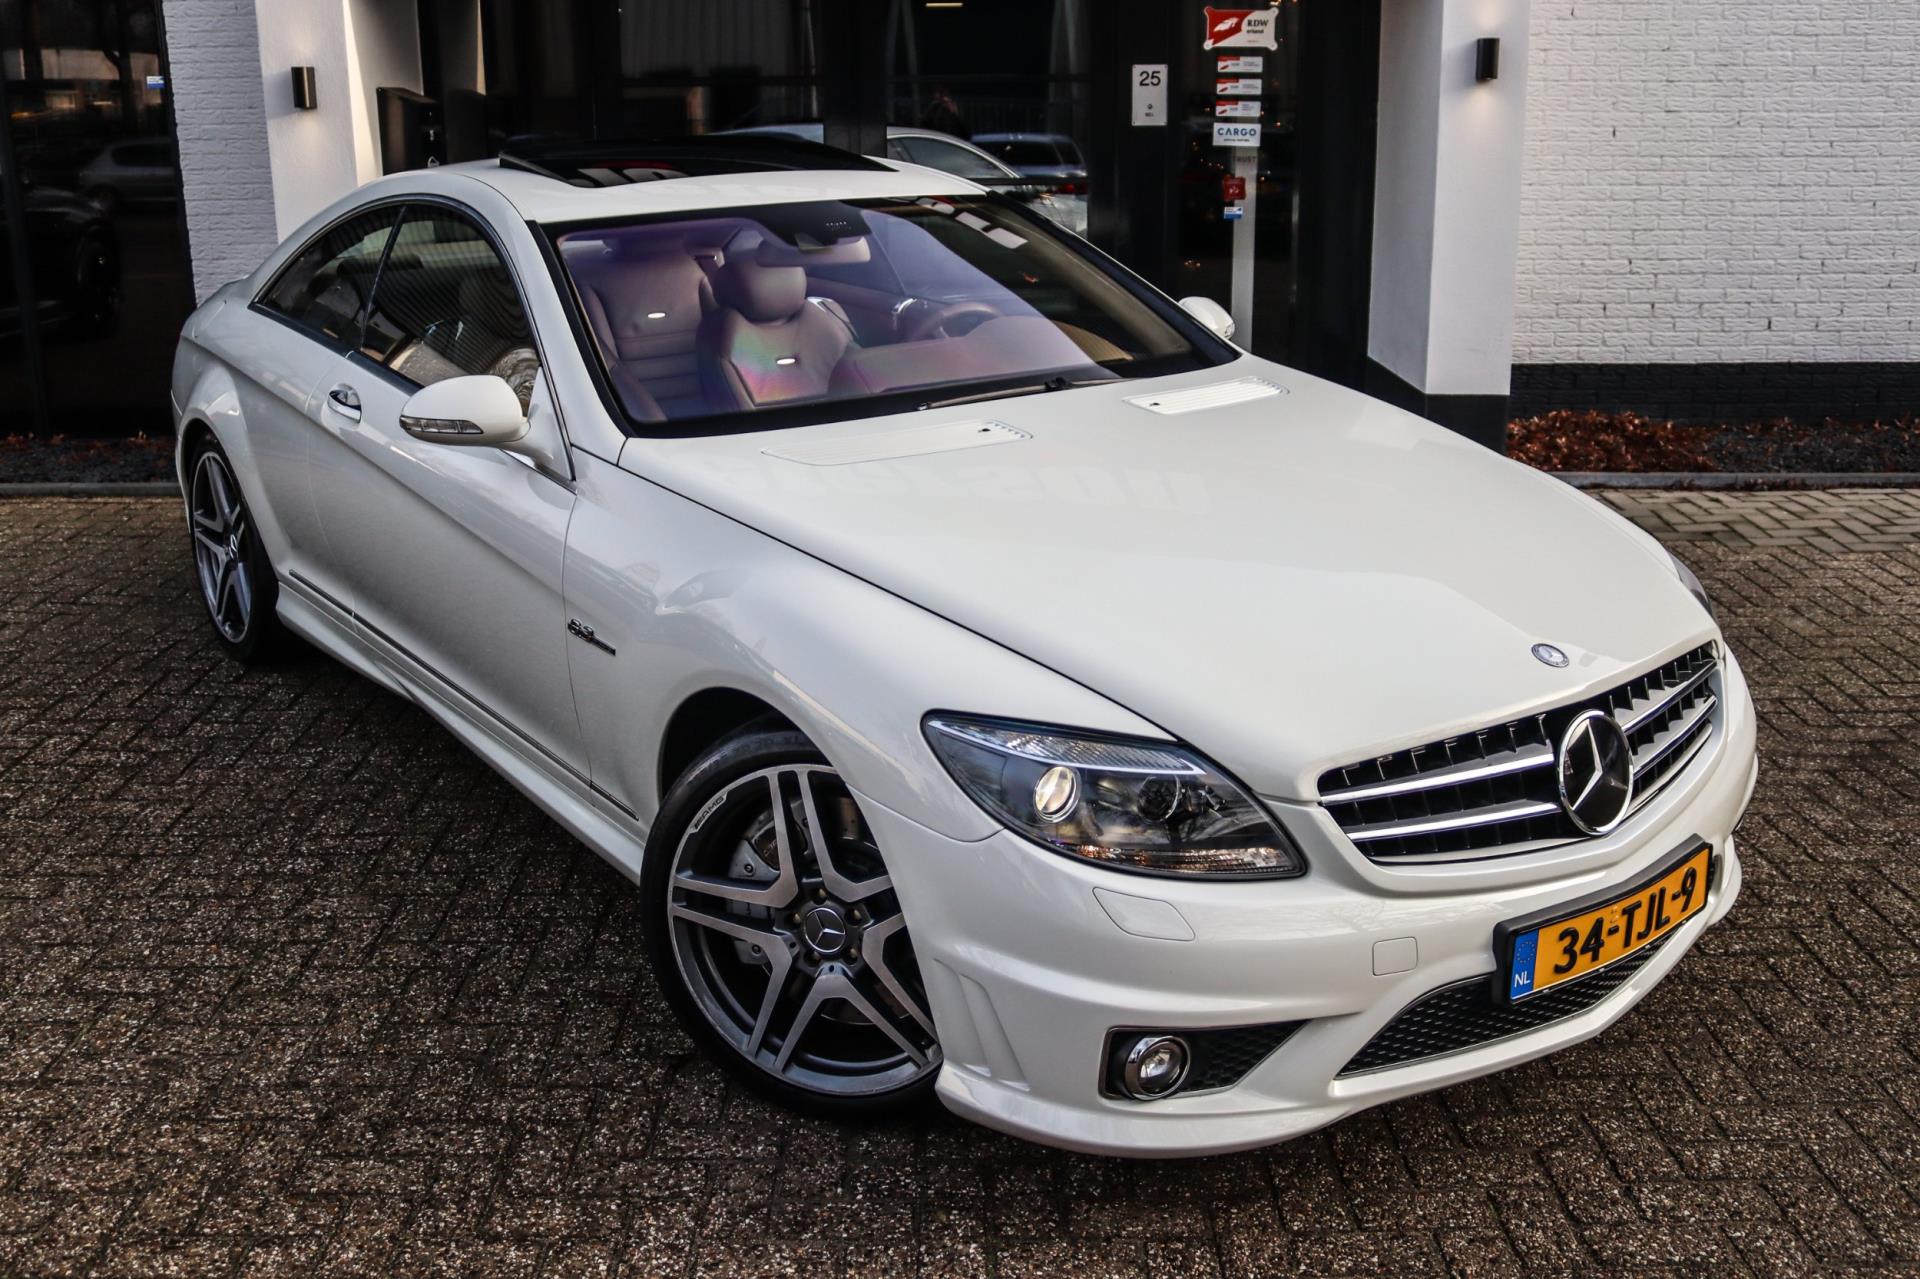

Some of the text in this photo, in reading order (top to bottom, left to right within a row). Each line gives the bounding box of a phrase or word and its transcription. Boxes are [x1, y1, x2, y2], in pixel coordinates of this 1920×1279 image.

[1247, 19, 1269, 27] RDW
[1139, 71, 1161, 86] 25
[1217, 127, 1257, 136] CARGO
[1553, 867, 1697, 974] 34-TJL-9
[1514, 971, 1531, 988] NL
